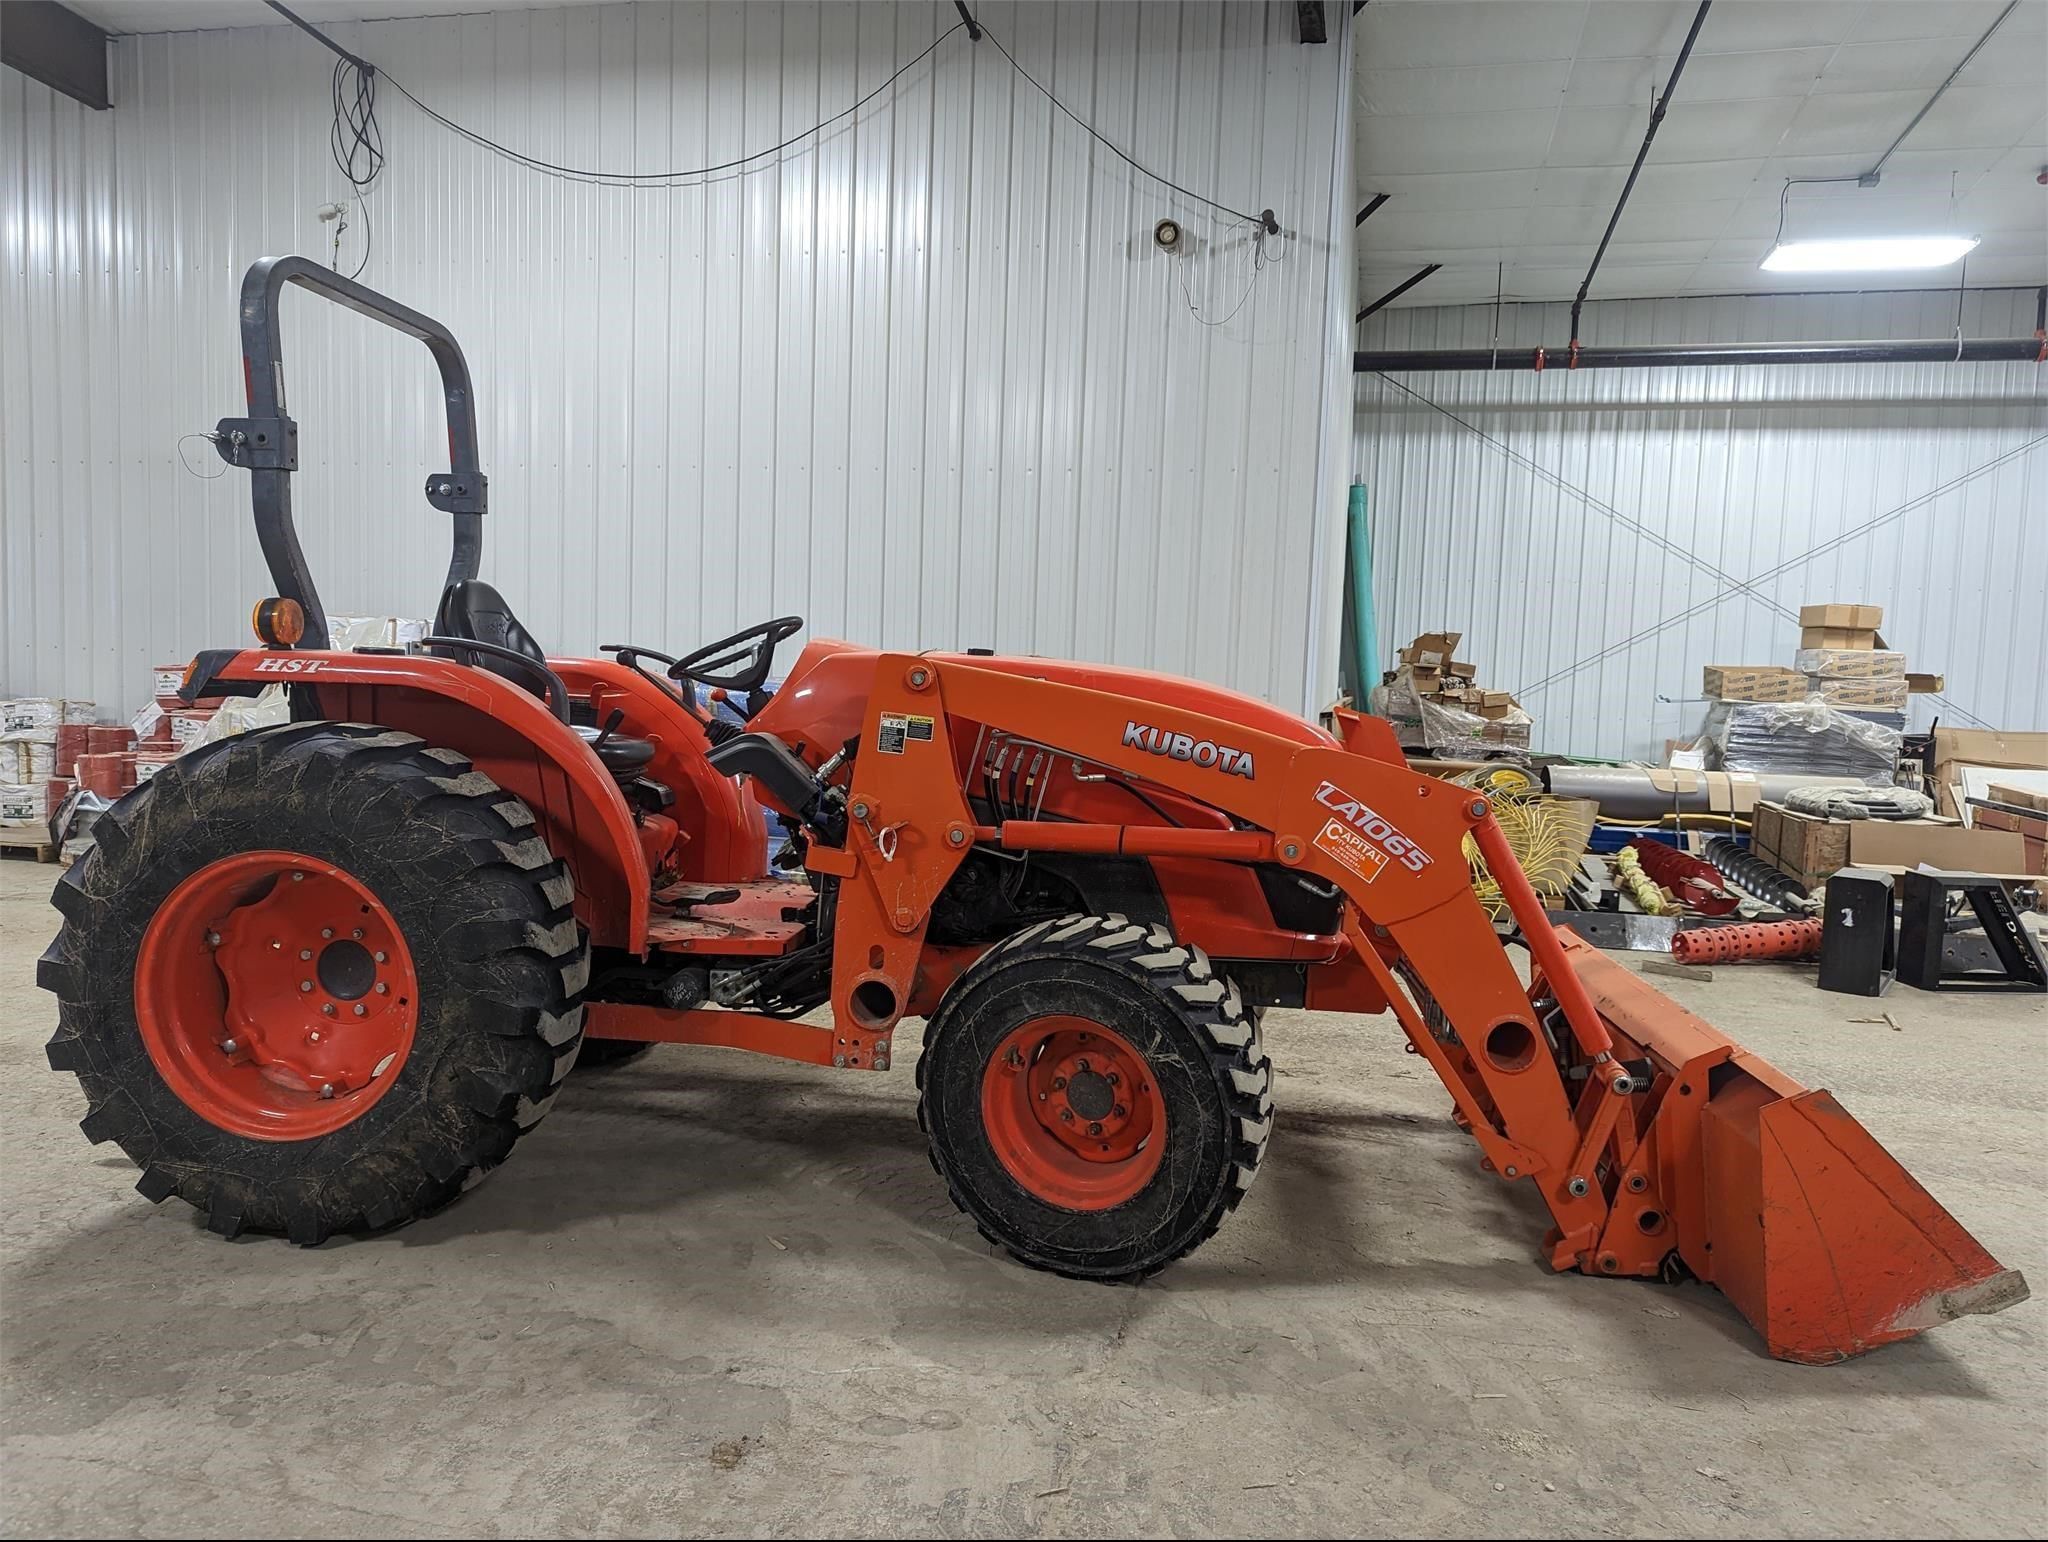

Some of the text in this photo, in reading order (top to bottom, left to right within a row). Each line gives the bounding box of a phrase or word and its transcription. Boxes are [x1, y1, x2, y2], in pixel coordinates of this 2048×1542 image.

[253, 658, 329, 673] HST
[1121, 720, 1255, 780] KUBOTA
[1315, 784, 1430, 871] LA1065
[1326, 823, 1381, 864] CAPITAL
[1345, 842, 1366, 862] KUBOTA
